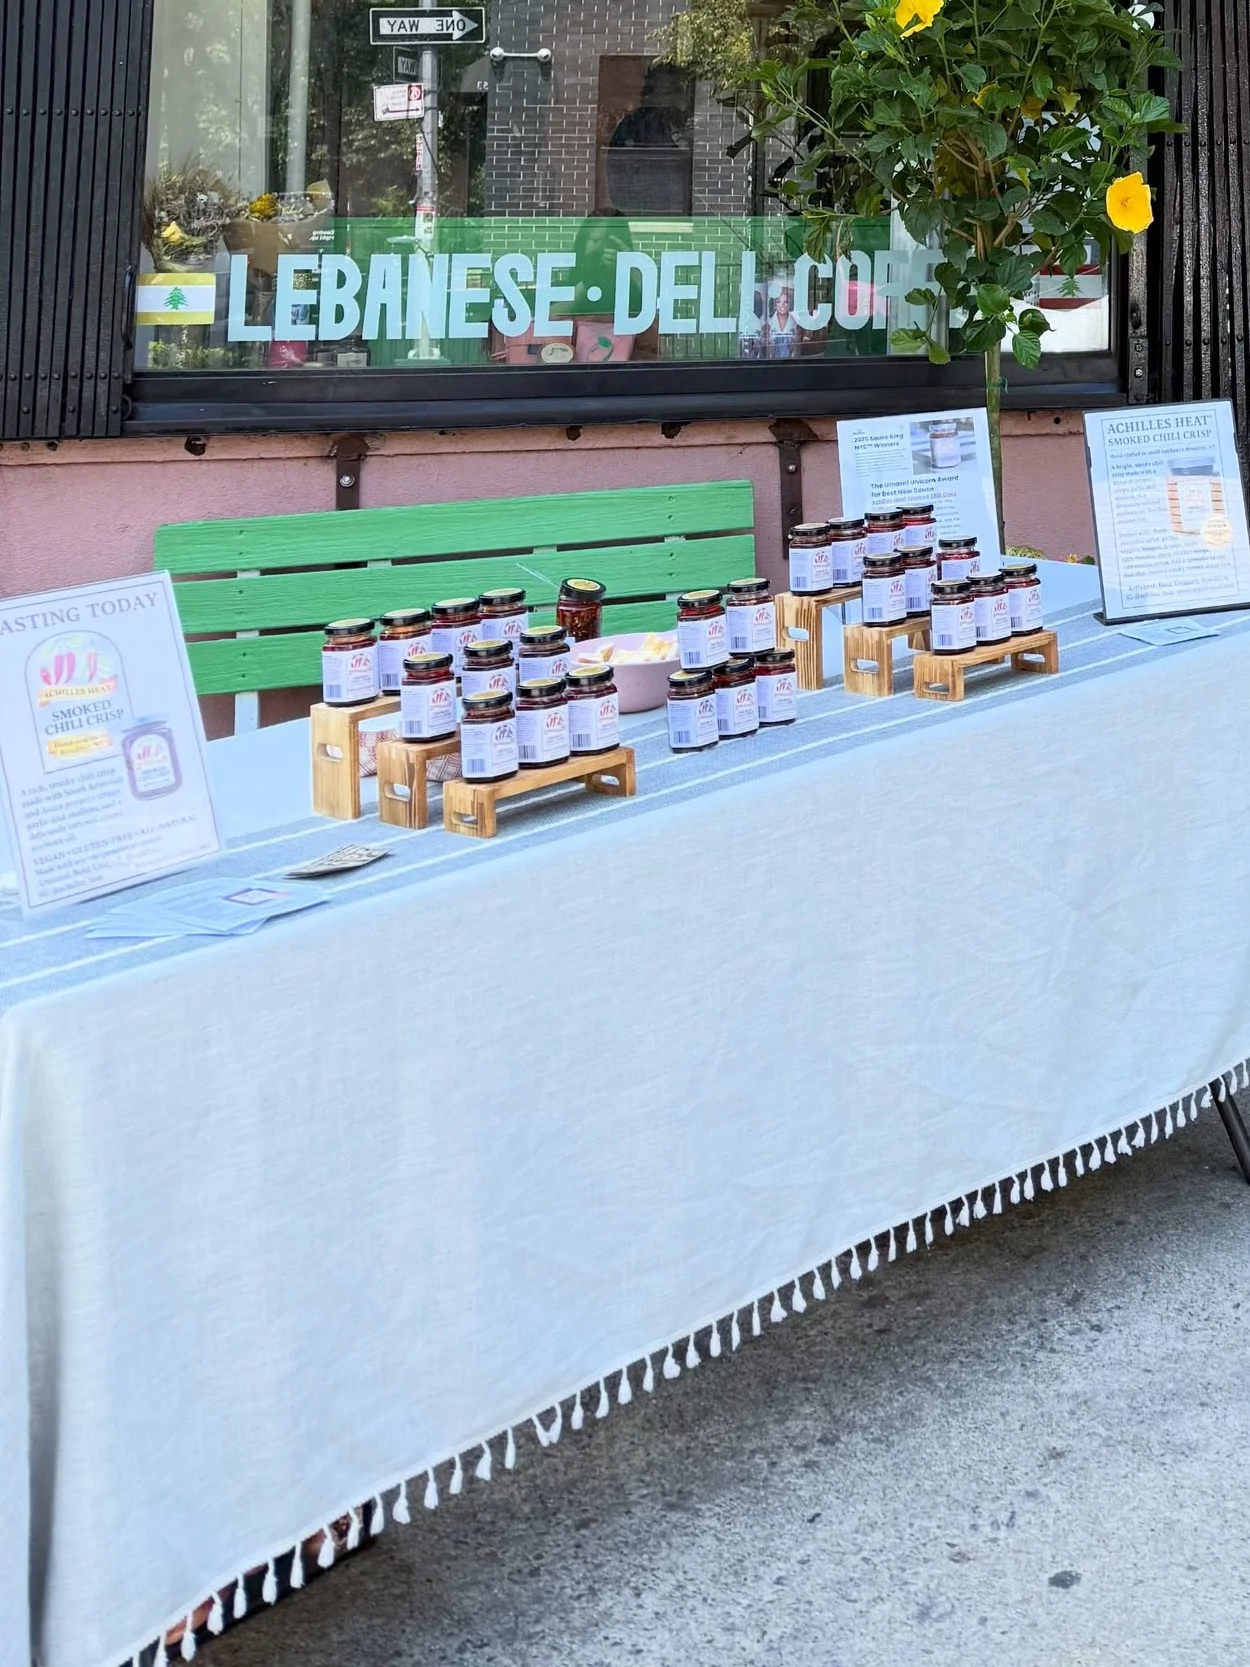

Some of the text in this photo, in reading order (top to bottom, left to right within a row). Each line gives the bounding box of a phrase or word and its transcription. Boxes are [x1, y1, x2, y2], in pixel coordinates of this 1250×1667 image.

[228, 250, 972, 342] LEBANESE DELI COFF
[1107, 417, 1172, 435] ACHILLES
[1108, 428, 1213, 447] SMOKED CHILI CRISP
[0, 592, 158, 635] ASTING TODAY
[45, 708, 124, 736] CHILI CRISP
[51, 700, 112, 723] SMOKED
[33, 850, 66, 866] VEGAN
